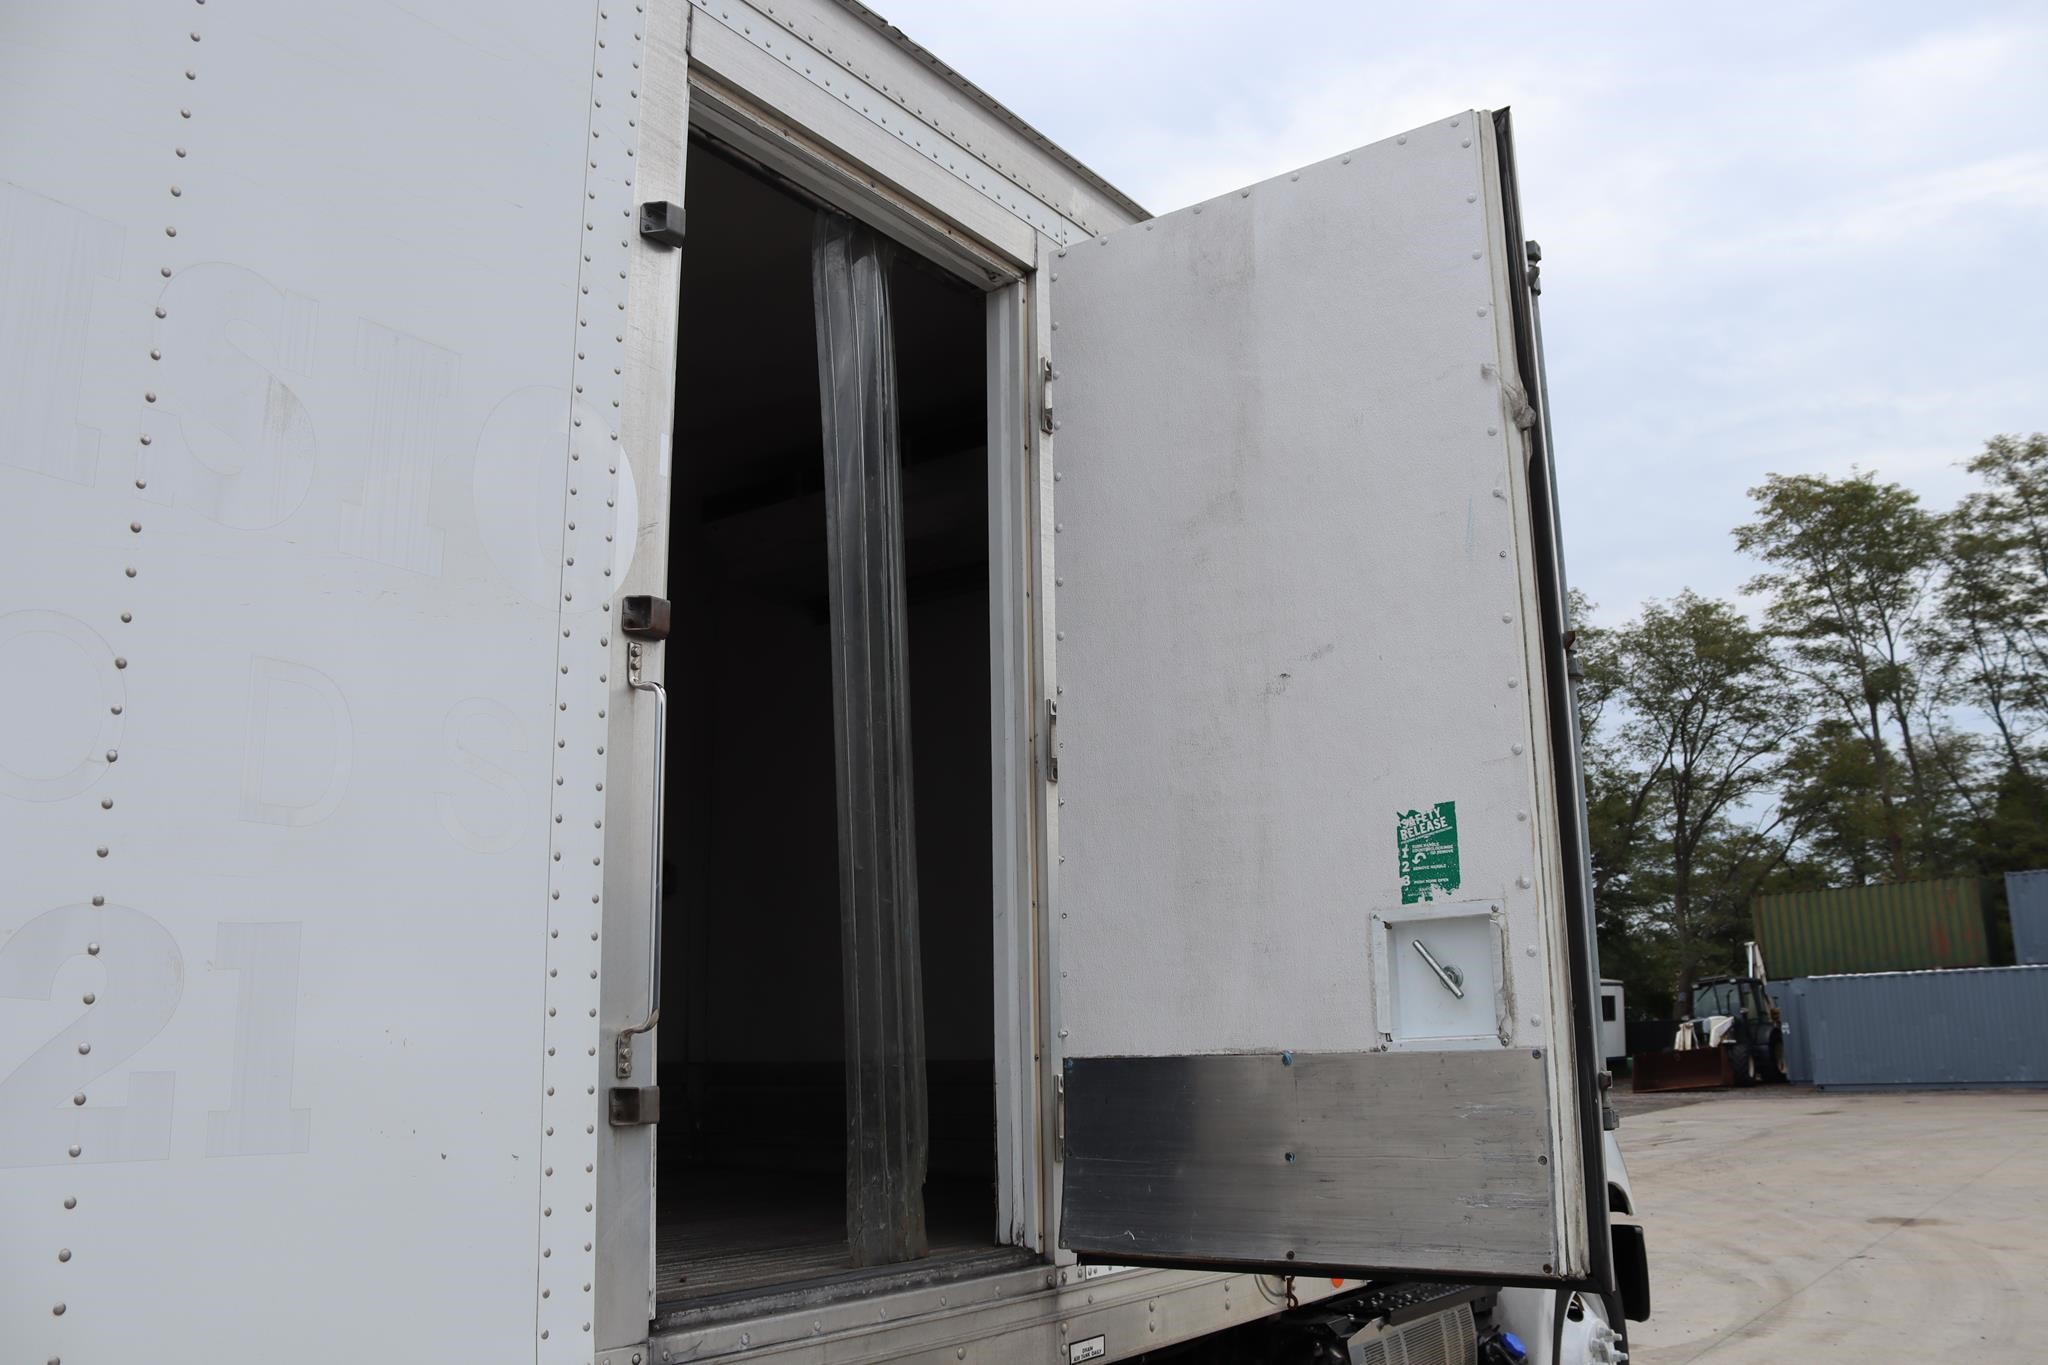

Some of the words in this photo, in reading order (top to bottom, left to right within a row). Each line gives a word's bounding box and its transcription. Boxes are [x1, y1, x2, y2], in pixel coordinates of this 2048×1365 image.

[1400, 807, 1440, 829] SAFETY
[1400, 816, 1448, 841] RELEASE
[1402, 861, 1410, 872] 2
